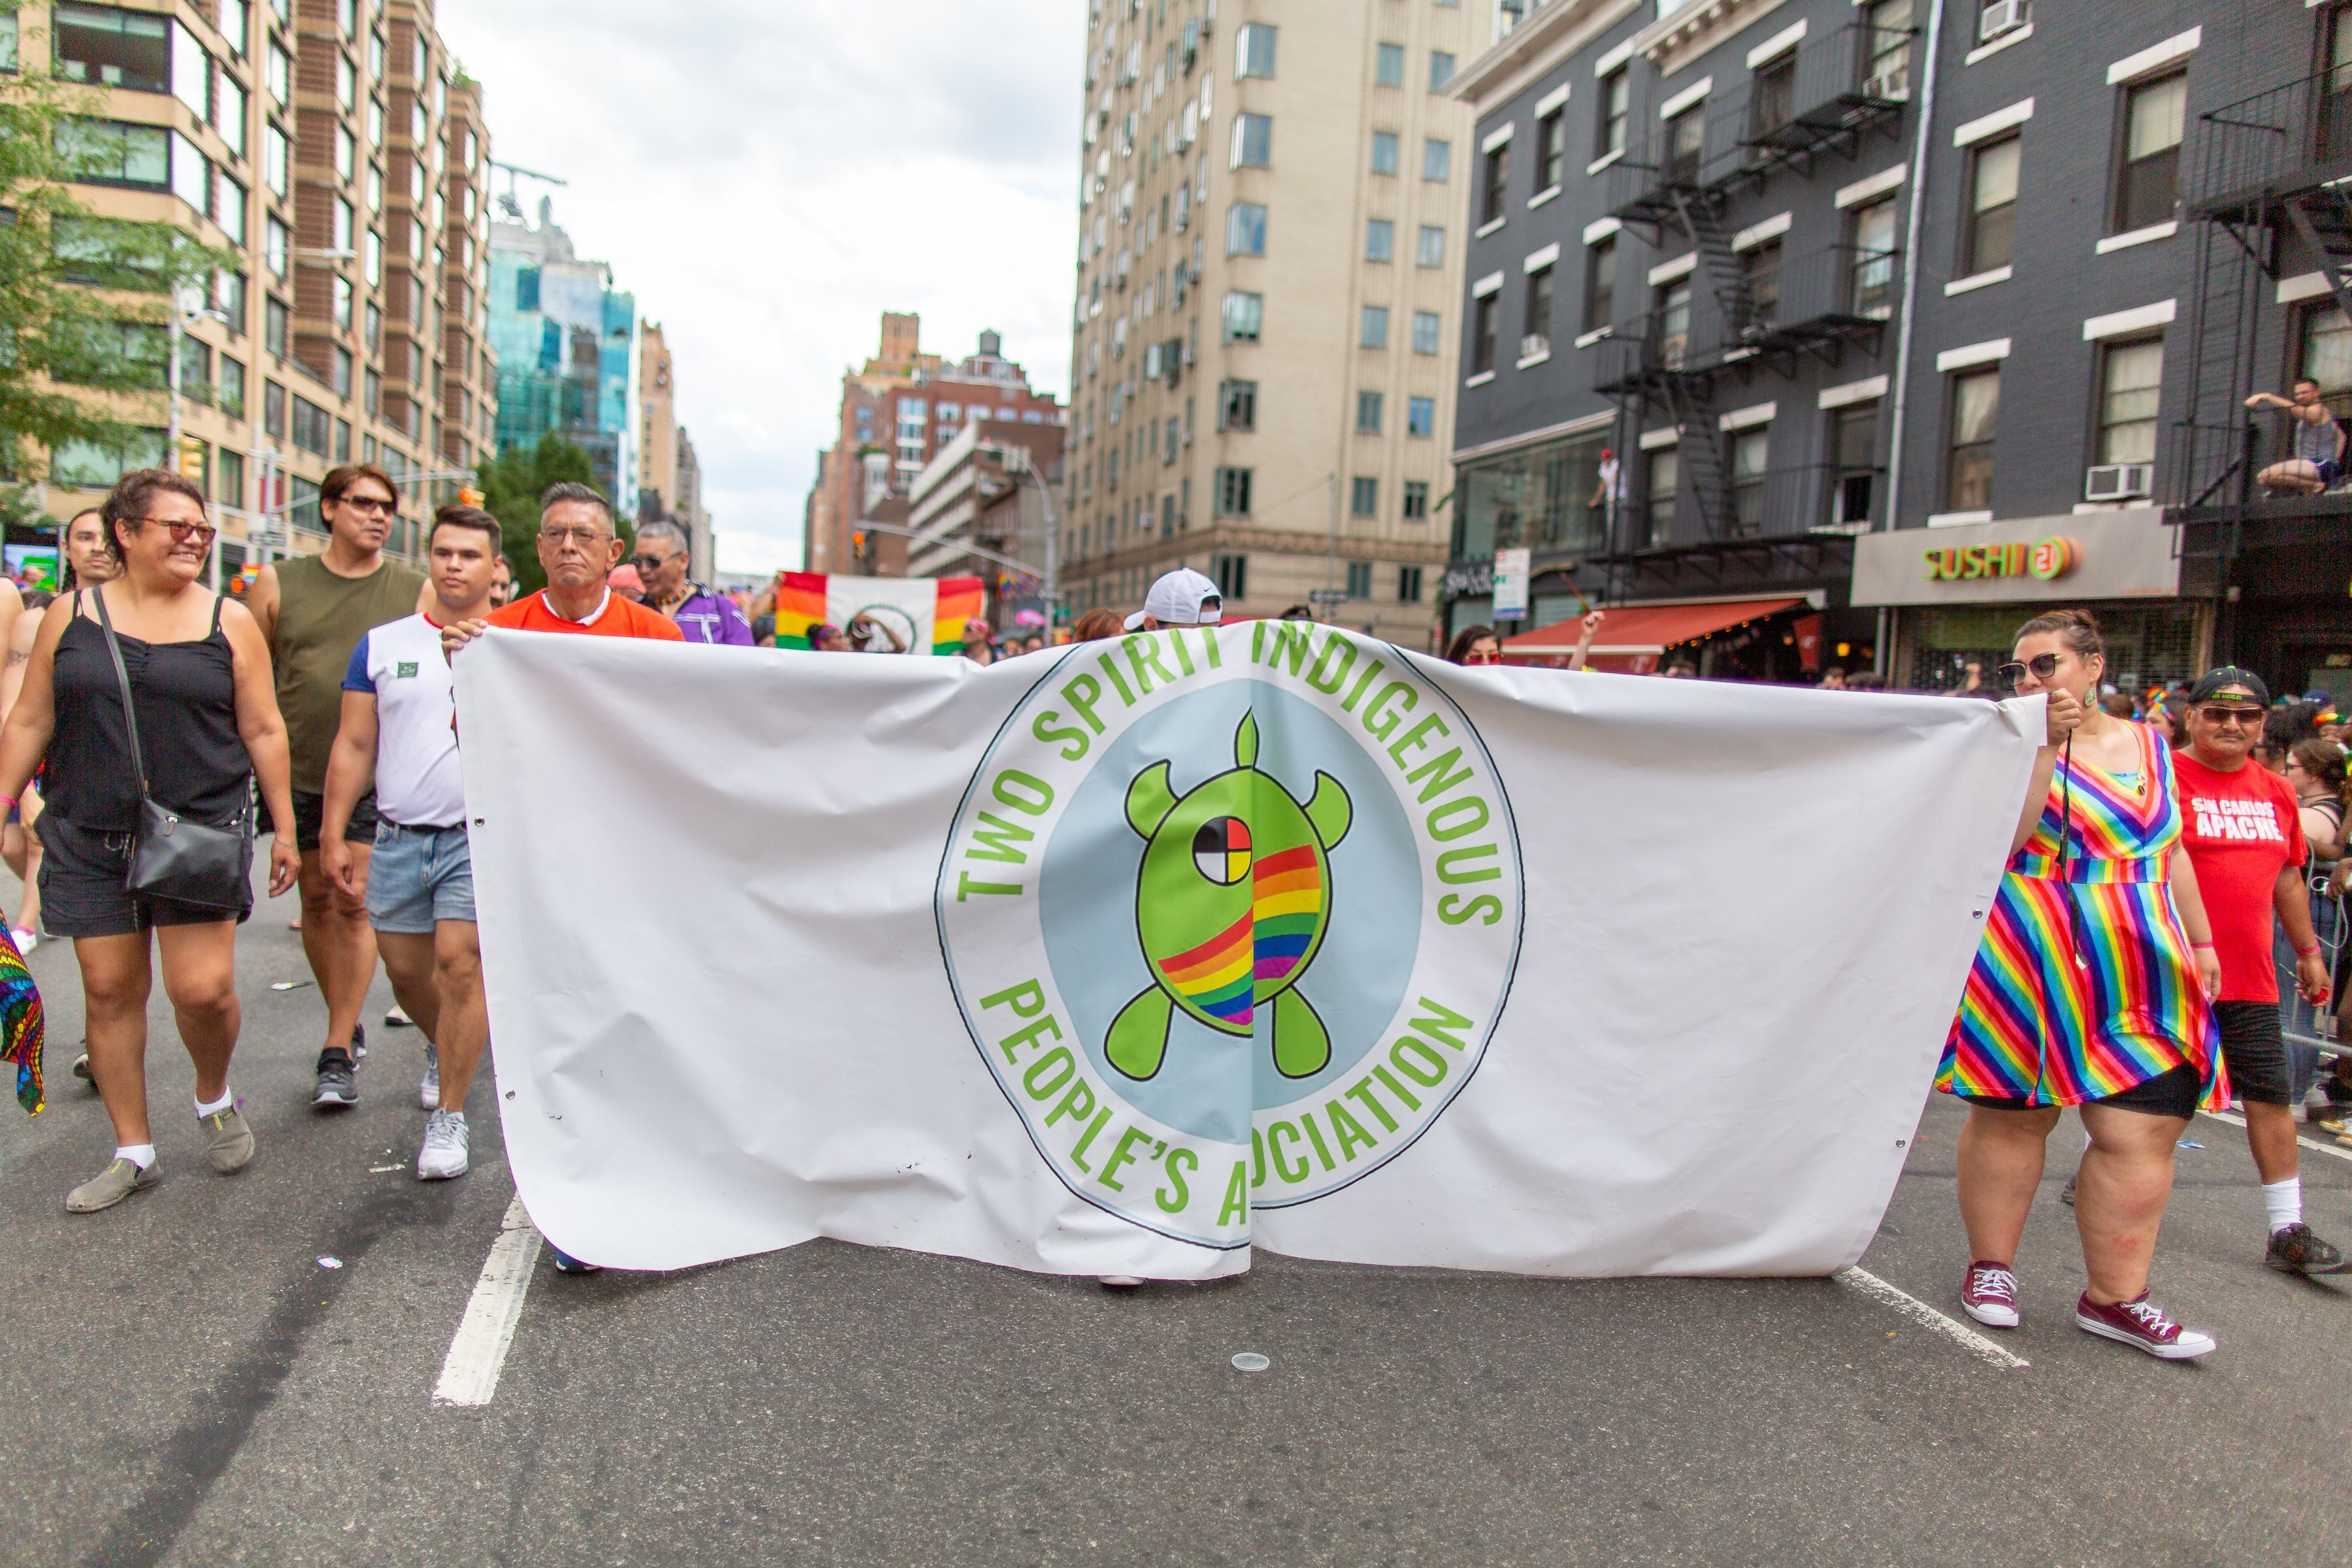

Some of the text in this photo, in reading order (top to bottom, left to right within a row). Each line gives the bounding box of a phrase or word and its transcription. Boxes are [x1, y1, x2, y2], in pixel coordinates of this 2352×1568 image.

[1923, 543, 2023, 581] SUSHI
[956, 768, 1054, 903] TWO
[1250, 619, 1503, 926] INDIGENOUS
[2197, 813, 2285, 841] APACHE
[2219, 799, 2275, 818] CARLOS
[979, 978, 1198, 1214] PEOPLE'S
